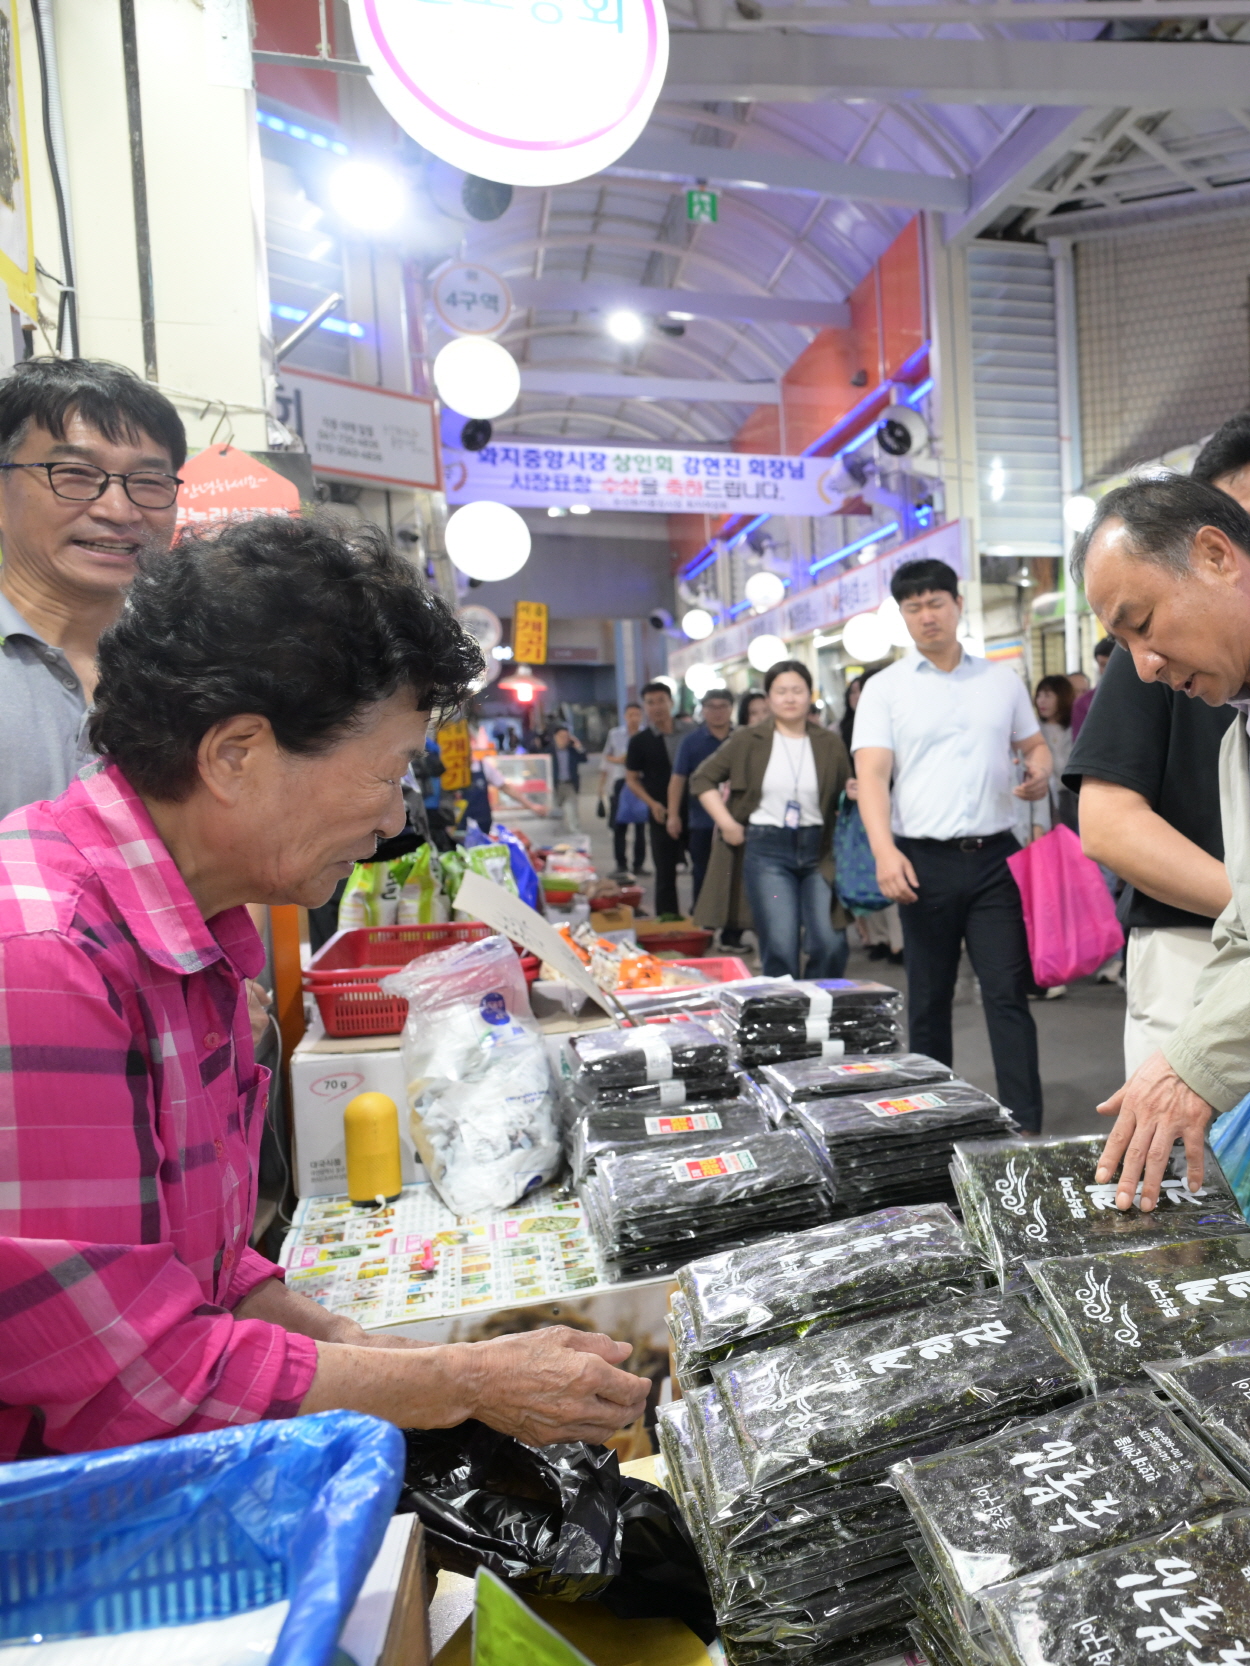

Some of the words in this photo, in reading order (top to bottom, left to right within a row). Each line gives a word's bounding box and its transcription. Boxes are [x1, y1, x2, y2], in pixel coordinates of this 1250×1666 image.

[477, 447, 607, 471] 화지중앙시장
[613, 453, 673, 474] 상인회
[748, 459, 805, 480] 회장님
[324, 1080, 338, 1090] 70
[1144, 1279, 1180, 1318] 즉석구이
[864, 1319, 1013, 1376] 재래김
[1131, 1457, 1162, 1483] 민호네
